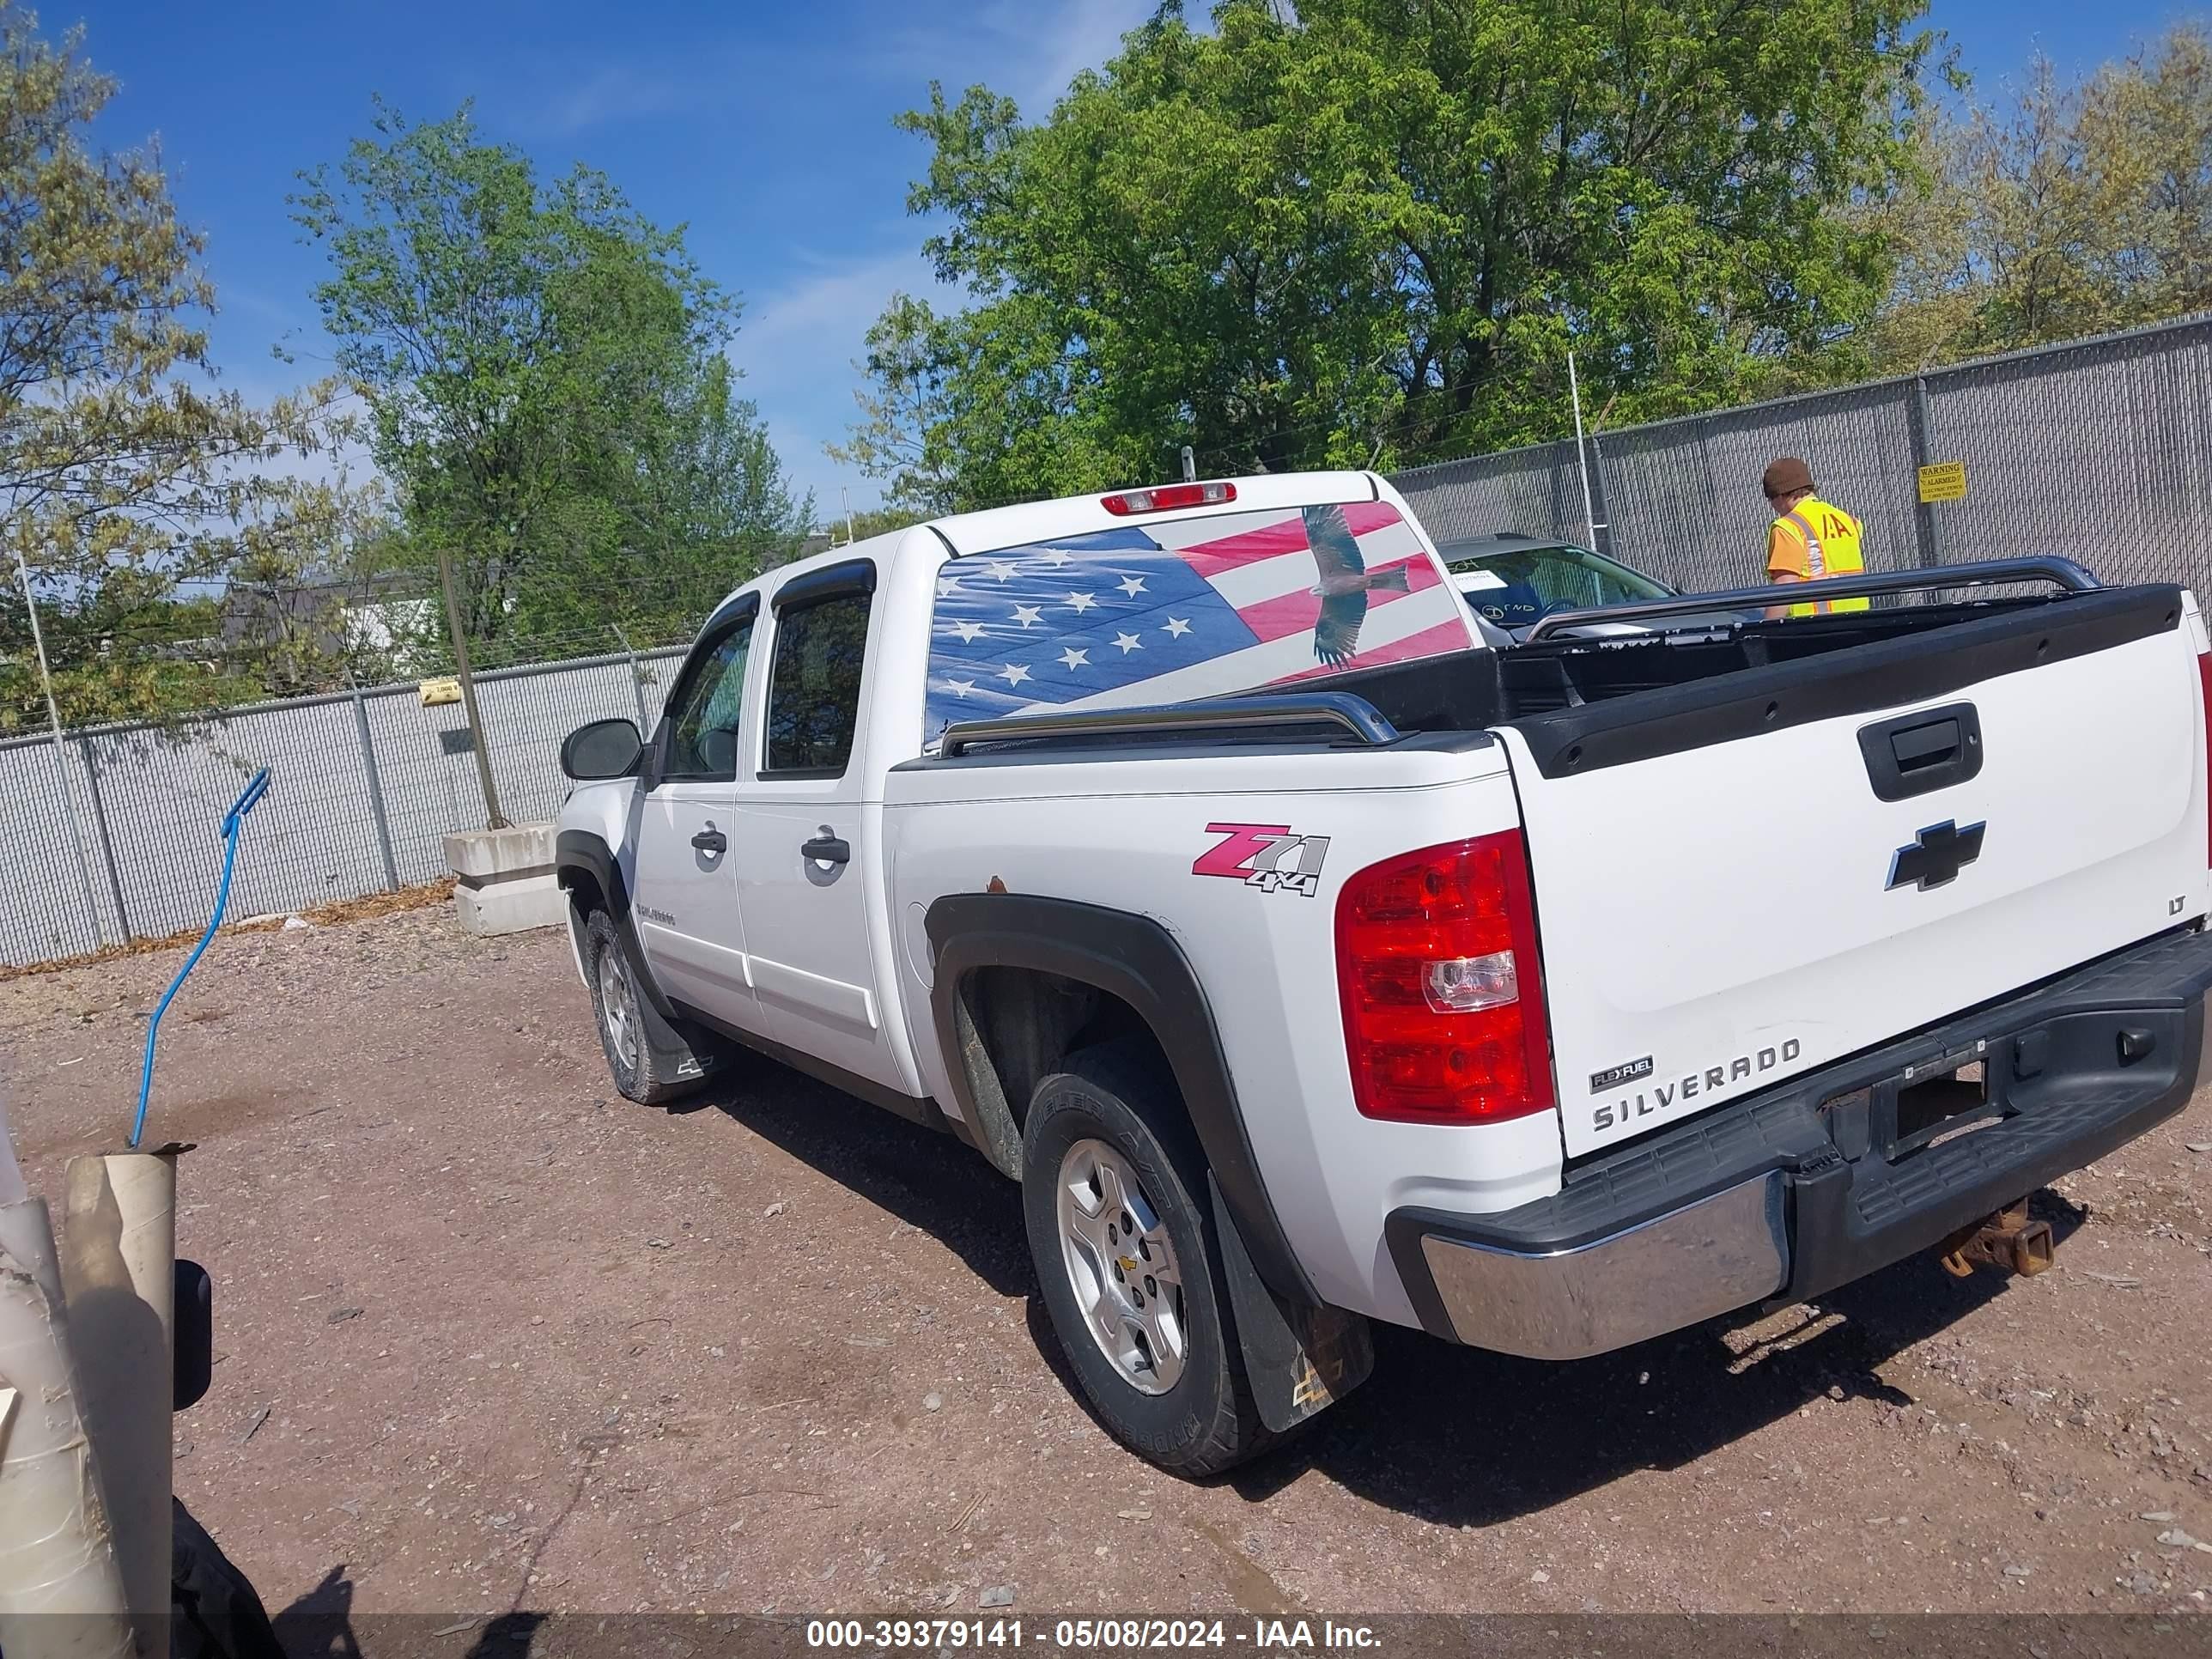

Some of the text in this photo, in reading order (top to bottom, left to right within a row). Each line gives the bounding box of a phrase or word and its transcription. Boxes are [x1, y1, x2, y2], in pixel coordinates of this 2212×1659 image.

[1921, 464, 1960, 476] WARNING
[1927, 477, 1956, 486] ALARMED
[1192, 822, 1332, 879] Z71
[2168, 895, 2186, 916] LT
[1593, 1037, 1802, 1133] SILVERADO
